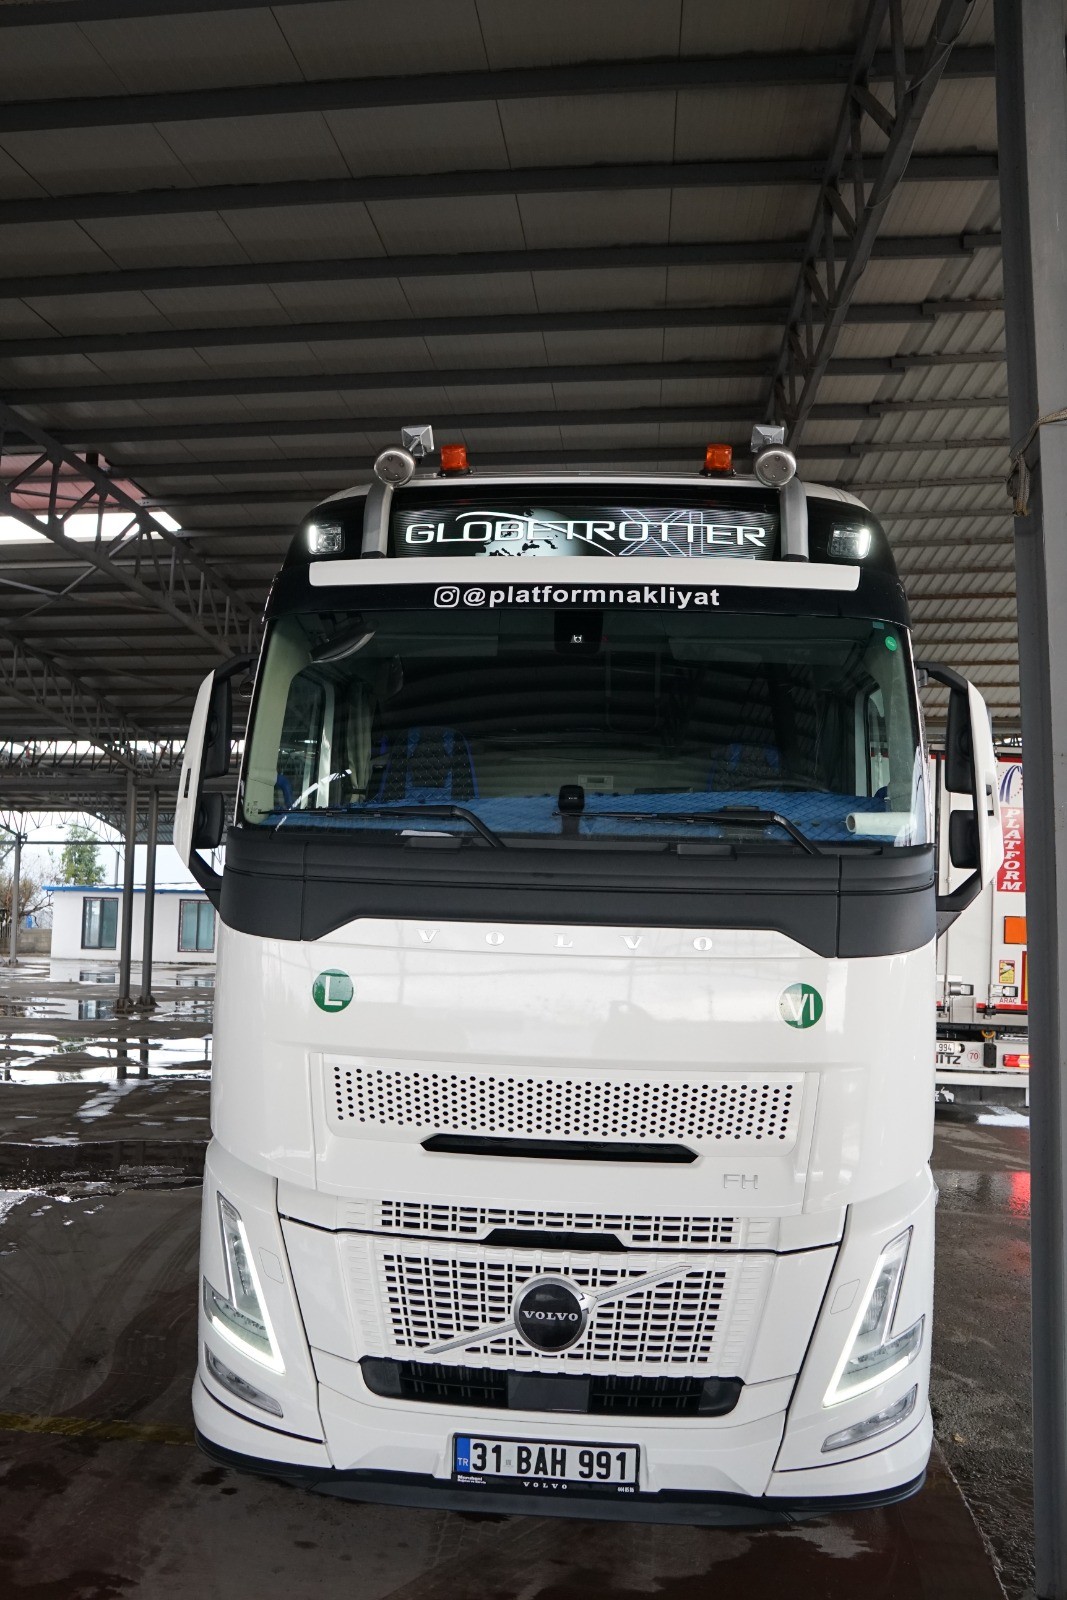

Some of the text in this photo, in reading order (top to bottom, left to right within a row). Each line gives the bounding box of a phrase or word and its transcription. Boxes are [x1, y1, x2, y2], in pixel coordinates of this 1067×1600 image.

[405, 518, 767, 548] GLOBETROTTER
[463, 585, 720, 609] @platformnakliyat
[1000, 808, 1023, 891] PLATFORM
[416, 928, 713, 952] VOLVO
[323, 975, 343, 1007] L
[936, 1054, 962, 1065] ITZ
[969, 1052, 979, 1061] 70
[723, 1173, 759, 1190] FH
[522, 1310, 579, 1322] VOLVO
[457, 1442, 627, 1481] TR 31 BAH 991
[522, 1481, 568, 1490] VOLVO
